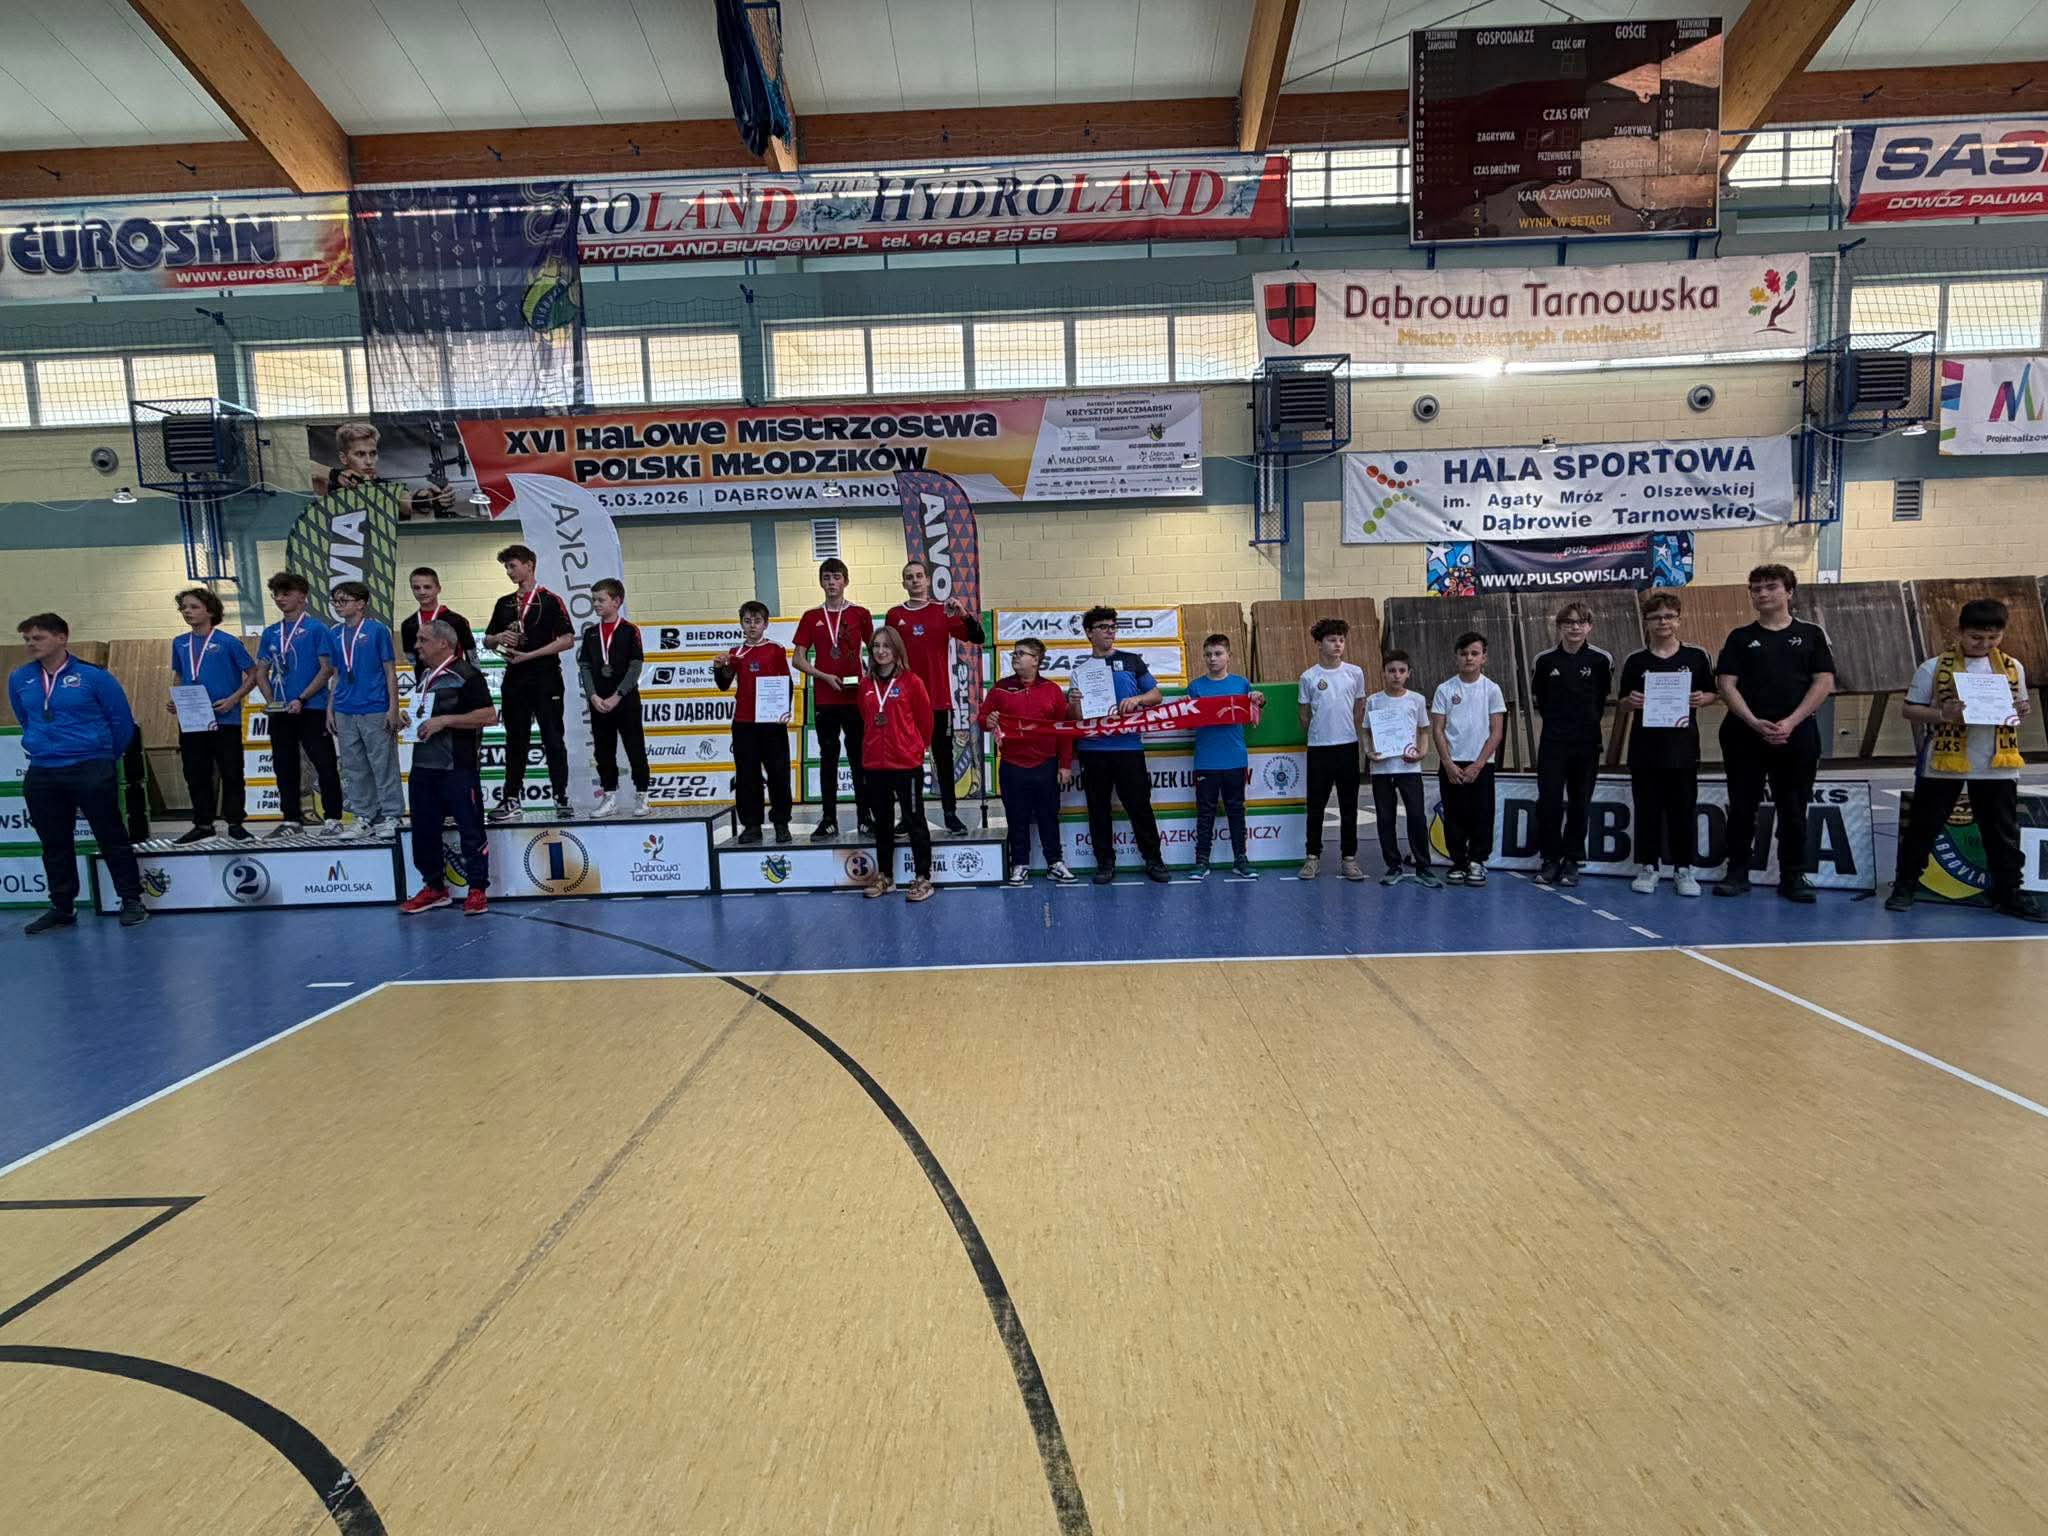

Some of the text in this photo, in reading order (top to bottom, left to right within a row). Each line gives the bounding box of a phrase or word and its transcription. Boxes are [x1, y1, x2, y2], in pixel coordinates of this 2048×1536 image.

[1477, 29, 1535, 46] GOSPODARZE
[1615, 23, 1647, 39] GOŚCIE
[1573, 40, 1586, 49] GRY
[1543, 107, 1591, 121] CZAS GRY
[1665, 109, 1674, 118] 10
[1477, 131, 1516, 142] ZAGRYWKA
[1614, 126, 1653, 136] ZAGRYWKA
[1876, 130, 2048, 181] SAS
[1473, 162, 1520, 176] CZAS DRUŻYNY
[1558, 166, 1572, 176] SET
[868, 168, 1225, 222] HYDROLAND
[1518, 187, 1612, 202] KARA ZAWODNIKA
[1887, 192, 2044, 209] DOWÓZ PALIWA
[574, 187, 798, 236] ROLAND
[1417, 210, 1425, 220] 2
[1519, 215, 1611, 229] WYNIK W SETACH
[8, 212, 278, 275] EUROSAN
[583, 227, 1059, 260] HYDROLAND.BIURO@WP.PL tel. 14 642 25 56
[175, 263, 319, 284] www.eurosan.pl
[1344, 276, 1721, 326] Dąbrowa Tarnowska
[1066, 404, 1172, 417] KRZYSZTOF KACZMARSKI
[505, 429, 566, 455] XVI
[1058, 455, 1114, 464] MAŁOPOLSKA
[1443, 446, 1756, 485] HALA SPORTOWA
[597, 483, 900, 507] 5.03.2026 DĄBROWA ARNO
[1443, 495, 1471, 508] im.
[1487, 493, 1543, 510] Agaty
[1560, 489, 1603, 504] Mróz
[1643, 482, 1755, 500] Olszewskiej
[1482, 513, 1593, 536] Dąbrowie
[1613, 503, 1756, 526] Tarnowskiej
[1480, 567, 1648, 588] WWW.PULSPOWISLA.PL
[679, 666, 705, 676] Bank
[686, 677, 713, 685] Dąbrow
[641, 702, 735, 723] LKS DĄBROV
[647, 743, 687, 756] karnia
[648, 786, 717, 799] ZĘŚCI
[1076, 833, 1127, 846] POKI
[1131, 829, 1196, 846] ZĄZEK
[541, 842, 566, 882] 1
[1934, 833, 1986, 885] BROVIA
[629, 870, 681, 882] Tarnowska
[850, 857, 866, 880] 3
[233, 864, 259, 894] 2
[304, 883, 373, 894] MAŁOPOLSKA
